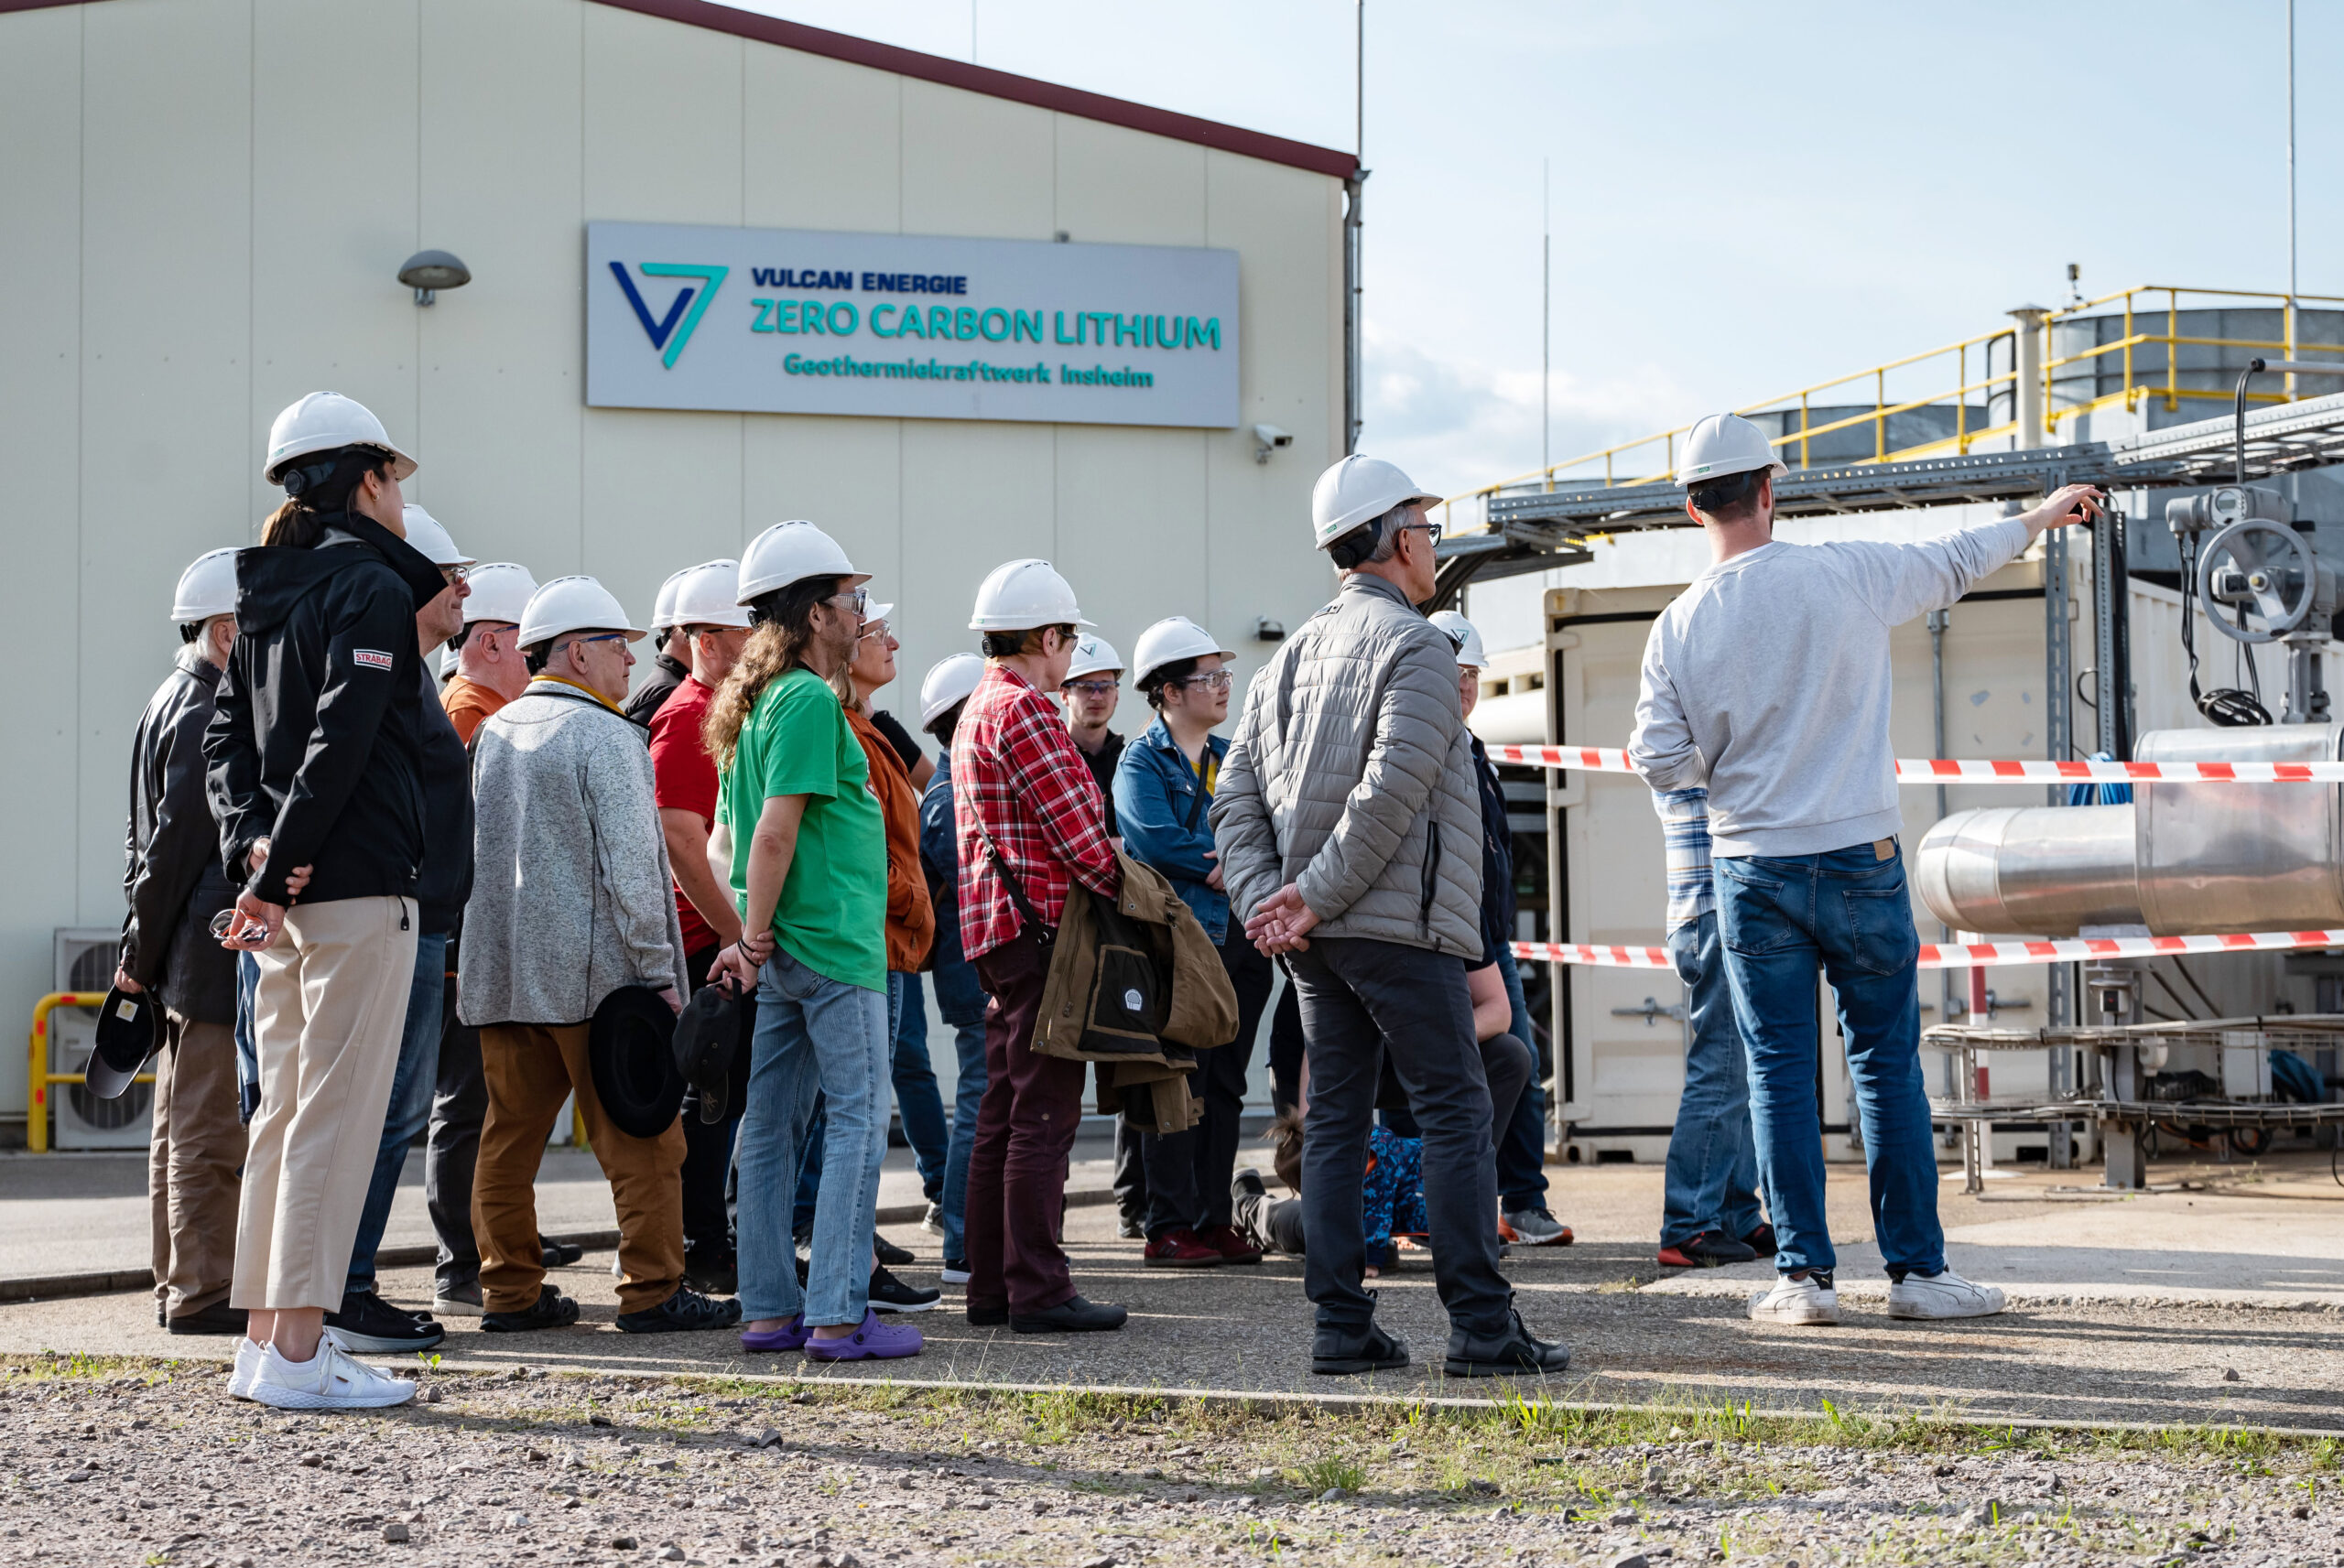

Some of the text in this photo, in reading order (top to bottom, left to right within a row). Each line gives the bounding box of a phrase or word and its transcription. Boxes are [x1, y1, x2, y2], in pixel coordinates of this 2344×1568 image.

[751, 267, 968, 295] VULCAN ENERGIE
[751, 297, 1221, 351] ZERO CARBON LITHIUM
[783, 352, 1155, 388] Geothermiekraftwerk Insheim
[355, 653, 392, 666] STRABAG
